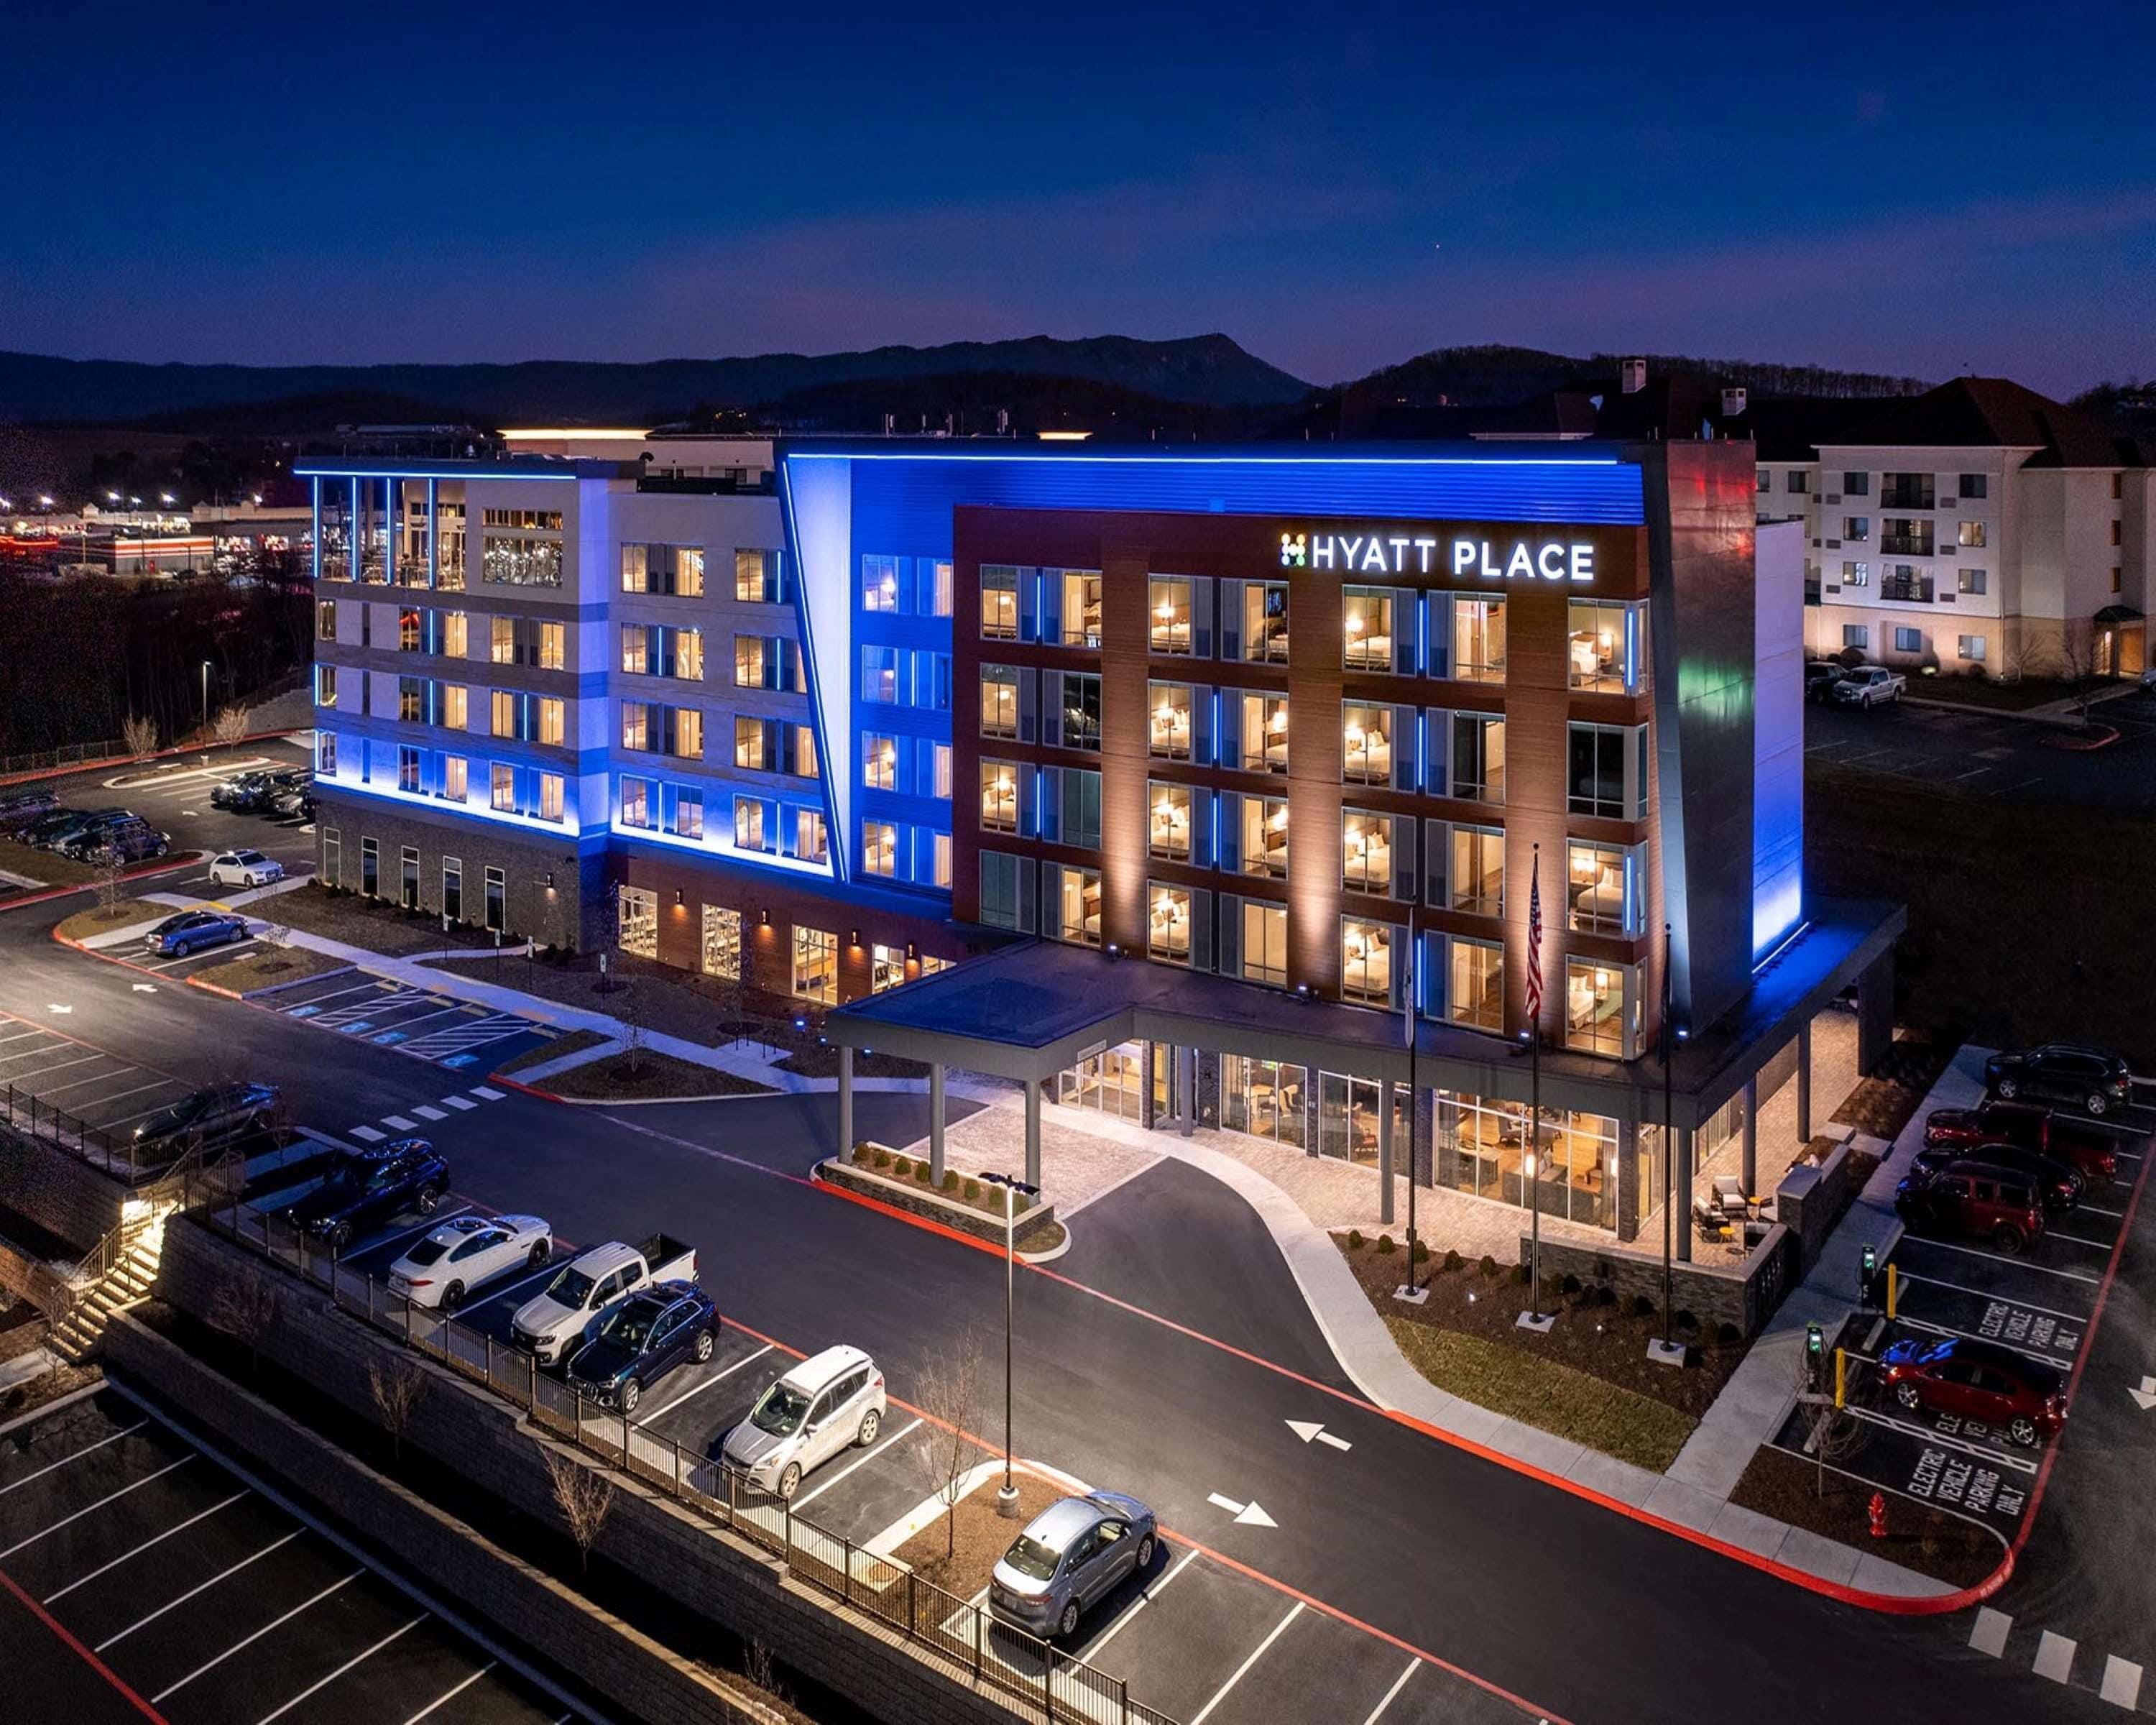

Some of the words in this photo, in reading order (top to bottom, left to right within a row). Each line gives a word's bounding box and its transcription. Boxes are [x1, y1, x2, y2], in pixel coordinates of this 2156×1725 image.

[1312, 535, 1436, 573] HYATT
[1454, 541, 1594, 580] PLACE
[1978, 1302, 2009, 1337] ELECTRIC
[2003, 1310, 2032, 1340] VEHICLE
[2027, 1317, 2056, 1348] PARKING
[2054, 1328, 2080, 1351] ONLY
[1907, 1448, 1946, 1497] ELECTRIC
[1936, 1459, 1973, 1502] VEHICLE
[1964, 1469, 1999, 1513] PARKING
[1995, 1484, 2025, 1516] ONLY
